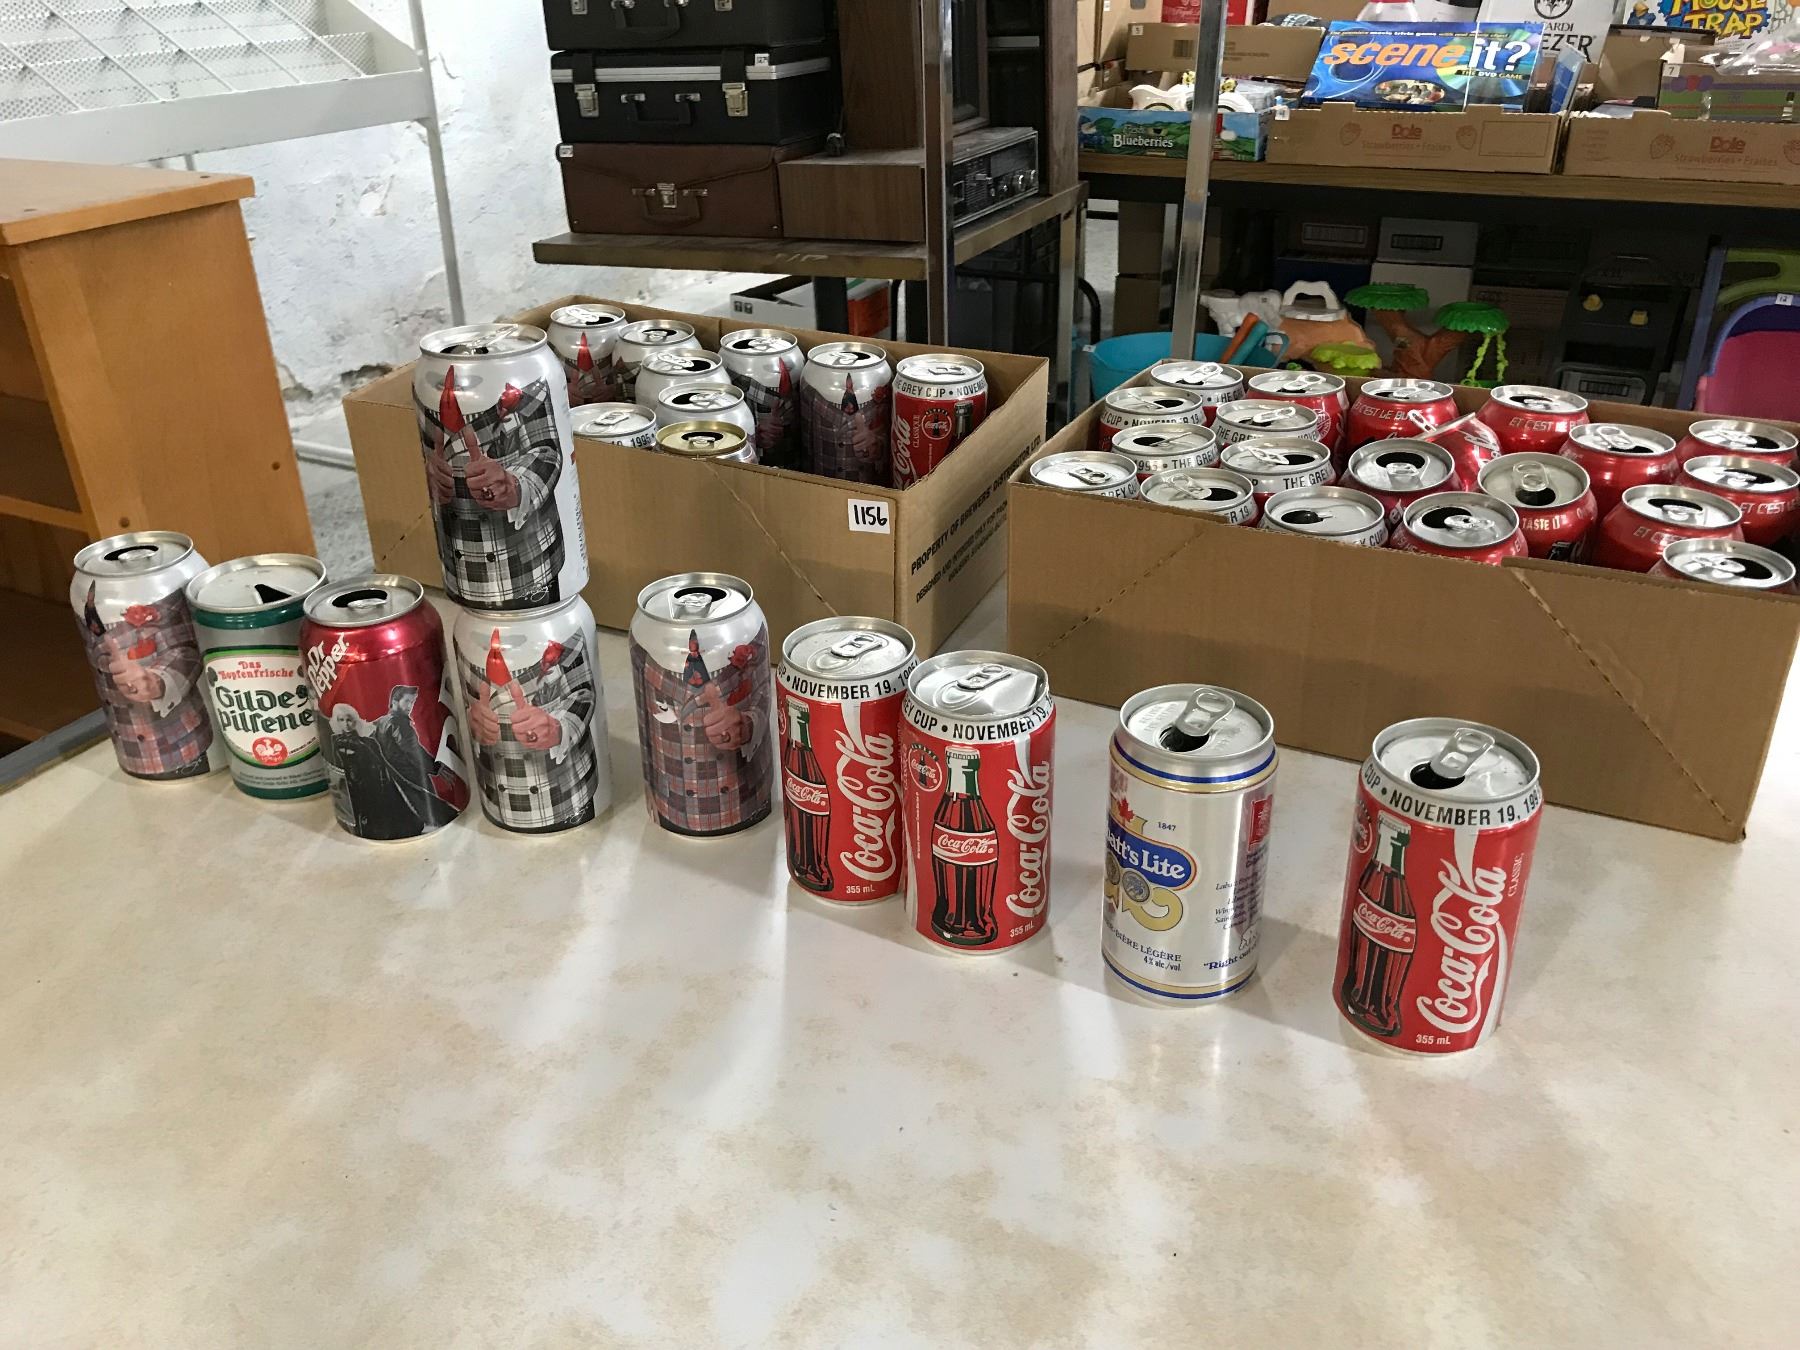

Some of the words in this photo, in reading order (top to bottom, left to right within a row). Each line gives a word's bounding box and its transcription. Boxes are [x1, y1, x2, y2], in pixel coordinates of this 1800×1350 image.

[1684, 12, 1762, 39] TRAP
[1323, 41, 1466, 68] scene
[1468, 38, 1532, 70] it?
[1113, 134, 1174, 148] Blueberries
[1392, 123, 1423, 139] Dole
[1710, 136, 1746, 153] Dole
[902, 382, 923, 396] GREY
[1107, 412, 1123, 426] CUP
[631, 433, 652, 448] 1995
[1217, 425, 1231, 440] THE
[1283, 475, 1307, 490] THE
[853, 504, 887, 526] 1156
[1522, 517, 1550, 531] TASTE
[911, 528, 949, 576] PROPERTY
[949, 520, 960, 537] OF
[307, 639, 327, 668] Dr
[238, 660, 261, 670] Das
[791, 675, 870, 700] NOVEMBER
[875, 680, 897, 696] 19,
[217, 708, 315, 734] Pilsene
[914, 711, 938, 732] CUP
[952, 716, 1035, 741] NOVEMBER
[786, 776, 822, 806] Coca-Cola
[1363, 763, 1381, 795] CUP
[1389, 788, 1491, 827] NOVEMBER
[1497, 804, 1521, 824] 19,
[835, 729, 896, 882] Coca-Cola
[1158, 821, 1177, 832] 1847
[937, 834, 993, 855] Coca-Cola
[1005, 760, 1051, 918] Coca-Cola
[1140, 849, 1186, 879] Lite
[846, 885, 861, 894] 355
[1009, 927, 1024, 938] 355
[1357, 902, 1411, 943] Coca-Cola
[1140, 944, 1182, 962] LÉGÈRE
[1416, 859, 1507, 1034] Coca-Cola
[1415, 1033, 1434, 1045] 355
[1436, 1035, 1451, 1045] mL
